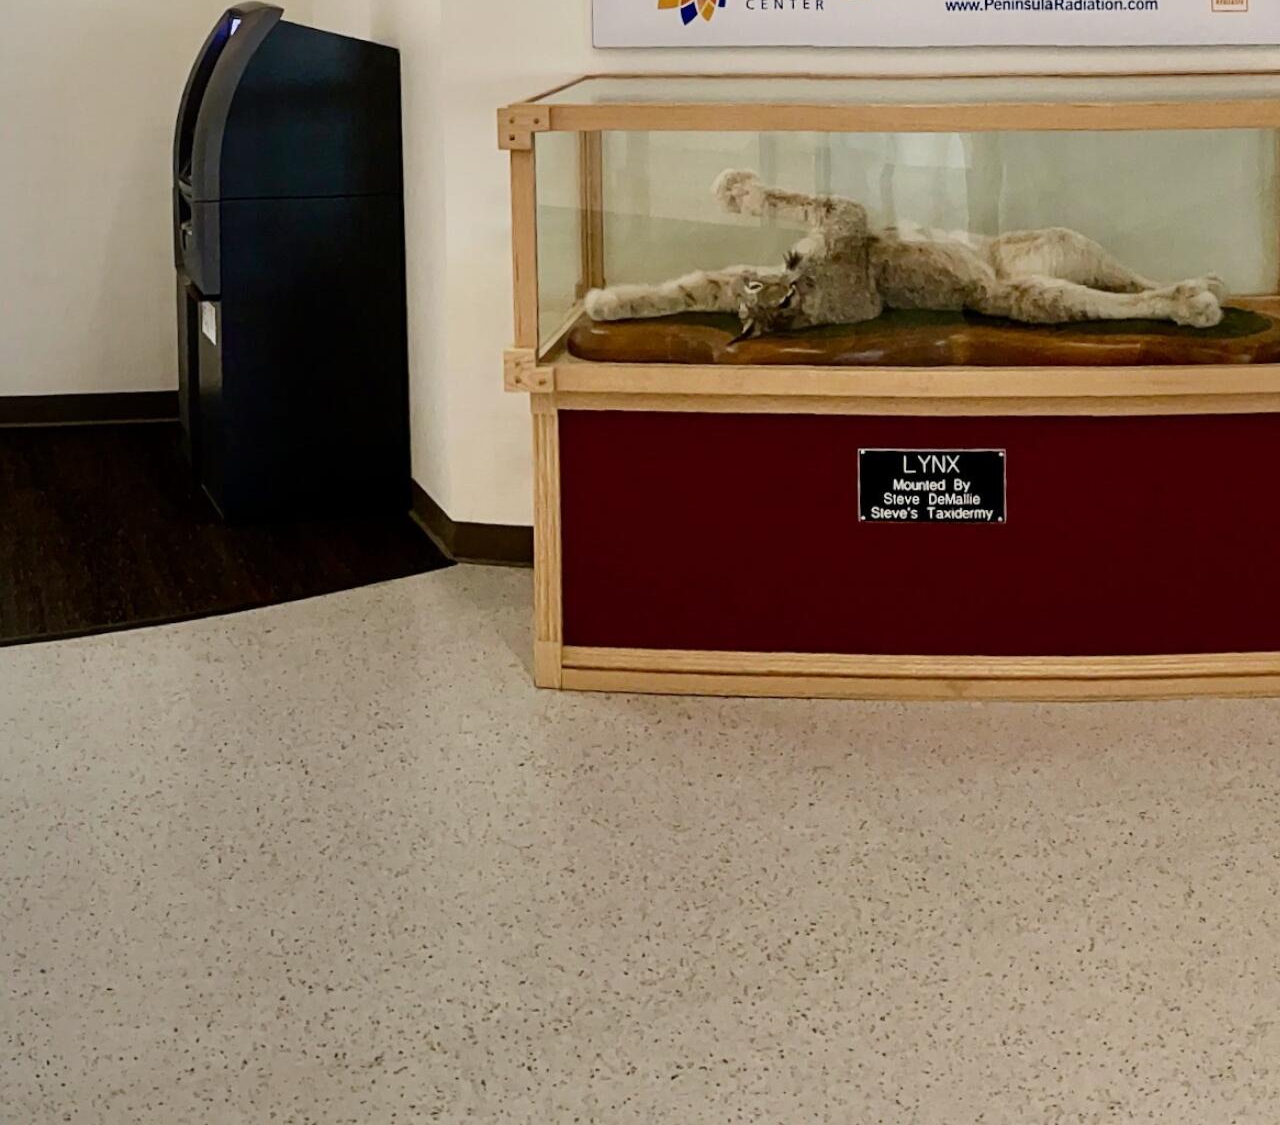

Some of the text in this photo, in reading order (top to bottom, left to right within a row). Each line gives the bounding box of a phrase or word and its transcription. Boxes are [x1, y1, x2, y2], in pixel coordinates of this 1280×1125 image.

[903, 454, 960, 473] LYNX
[892, 478, 971, 492] Mounted By
[883, 492, 920, 505] Steve
[870, 506, 994, 521] Steve's Taxidermy
